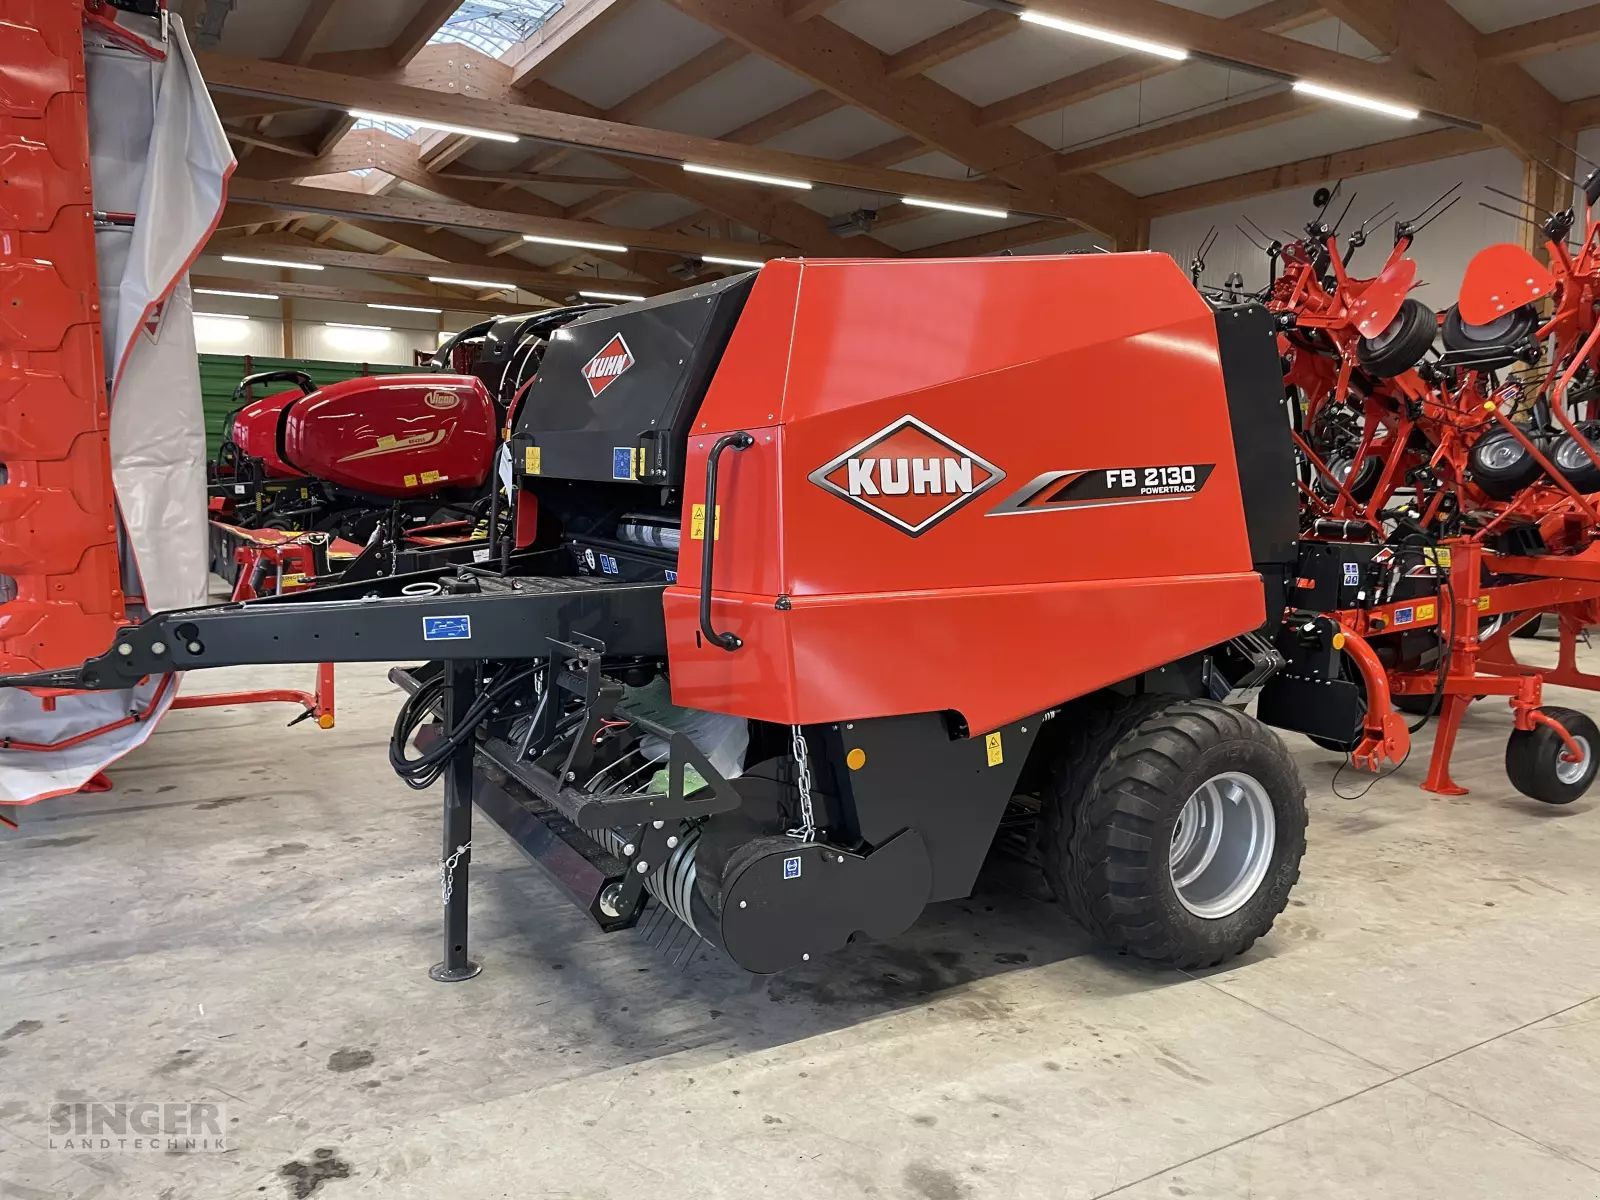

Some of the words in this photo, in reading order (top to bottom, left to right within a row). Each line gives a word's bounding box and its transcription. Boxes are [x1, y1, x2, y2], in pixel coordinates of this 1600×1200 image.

[587, 354, 628, 379] KUHN
[847, 457, 973, 496] KUHN
[1106, 469, 1136, 489] FB
[1144, 466, 1196, 486] 2130
[1140, 485, 1196, 495] POWERTRACK
